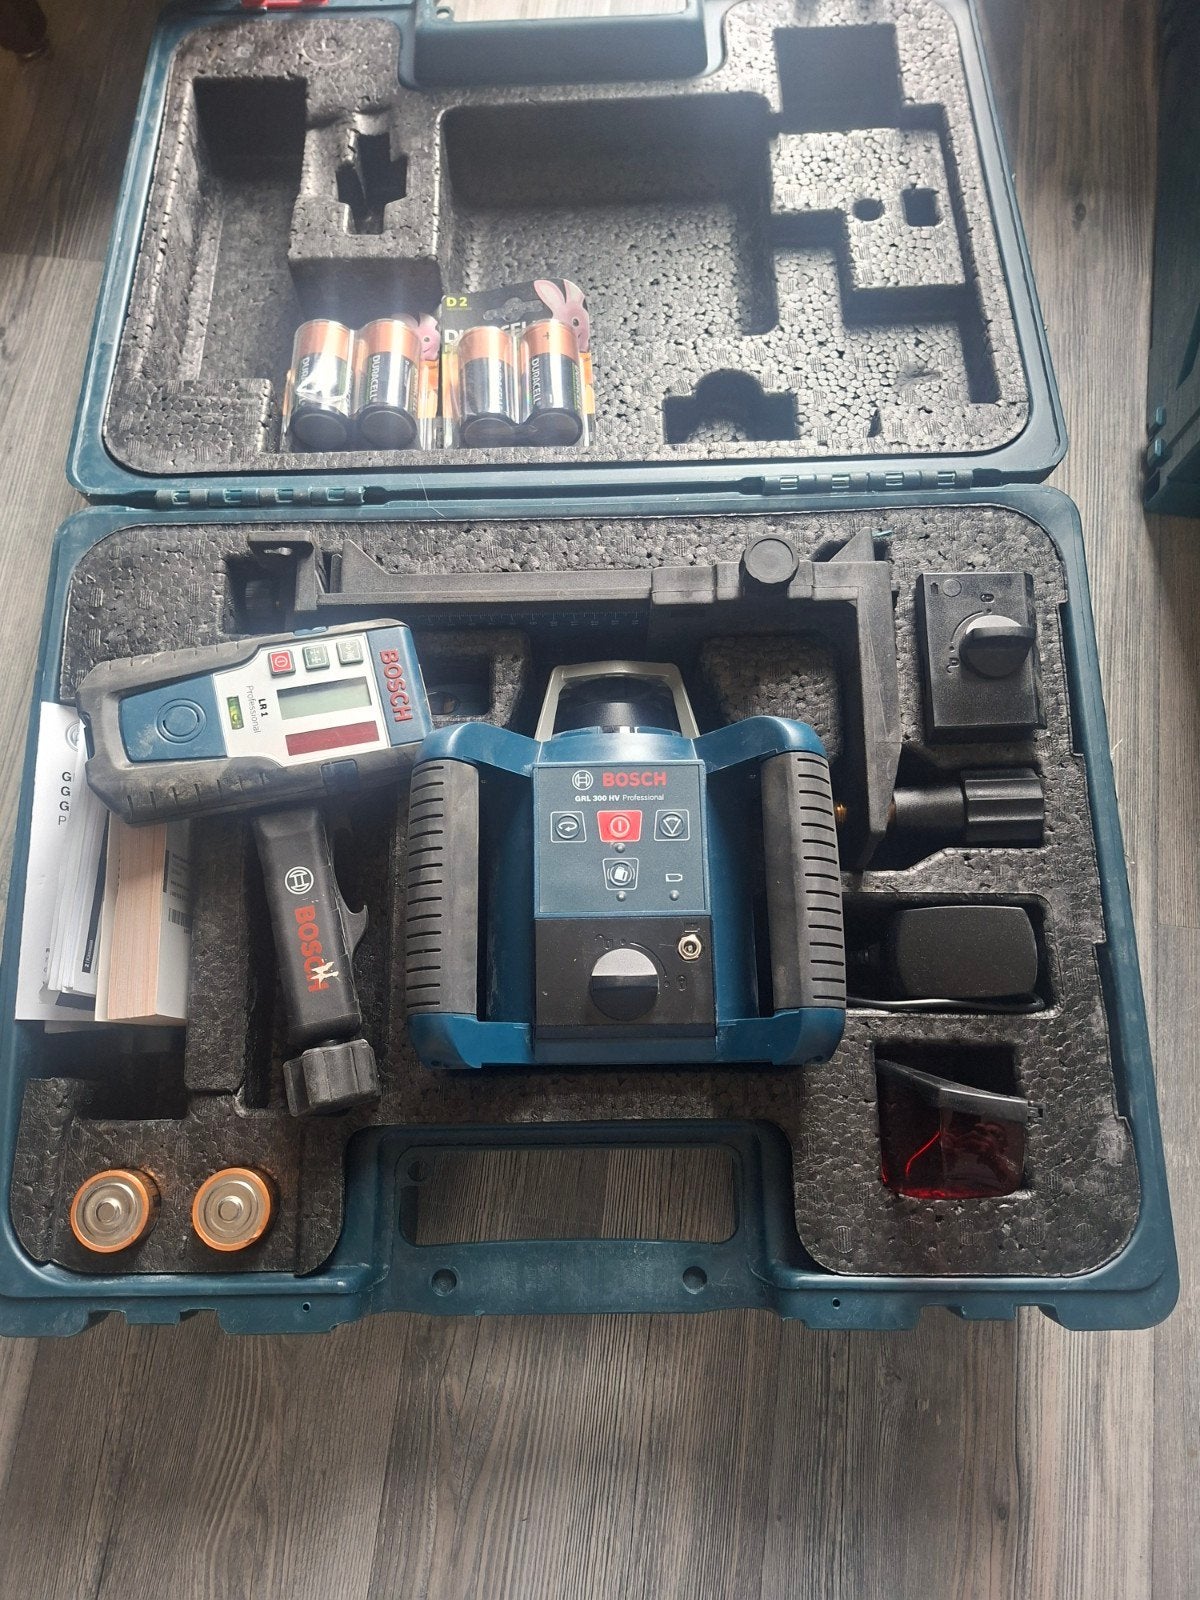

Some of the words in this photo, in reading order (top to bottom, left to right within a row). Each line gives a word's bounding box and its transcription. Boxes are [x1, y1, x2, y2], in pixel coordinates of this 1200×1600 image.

[446, 297, 457, 307] D
[459, 297, 468, 306] 2
[369, 354, 381, 400] DURACELL
[531, 358, 541, 404] DURACELL
[258, 698, 268, 710] LR
[380, 649, 413, 722] BOSCH
[245, 685, 262, 734] Professional
[574, 794, 592, 802] GRL
[593, 794, 607, 802] 300
[609, 794, 620, 802] HV
[622, 793, 665, 801] Professional
[602, 771, 667, 788] BOSCH
[294, 905, 330, 993] BOSCH
